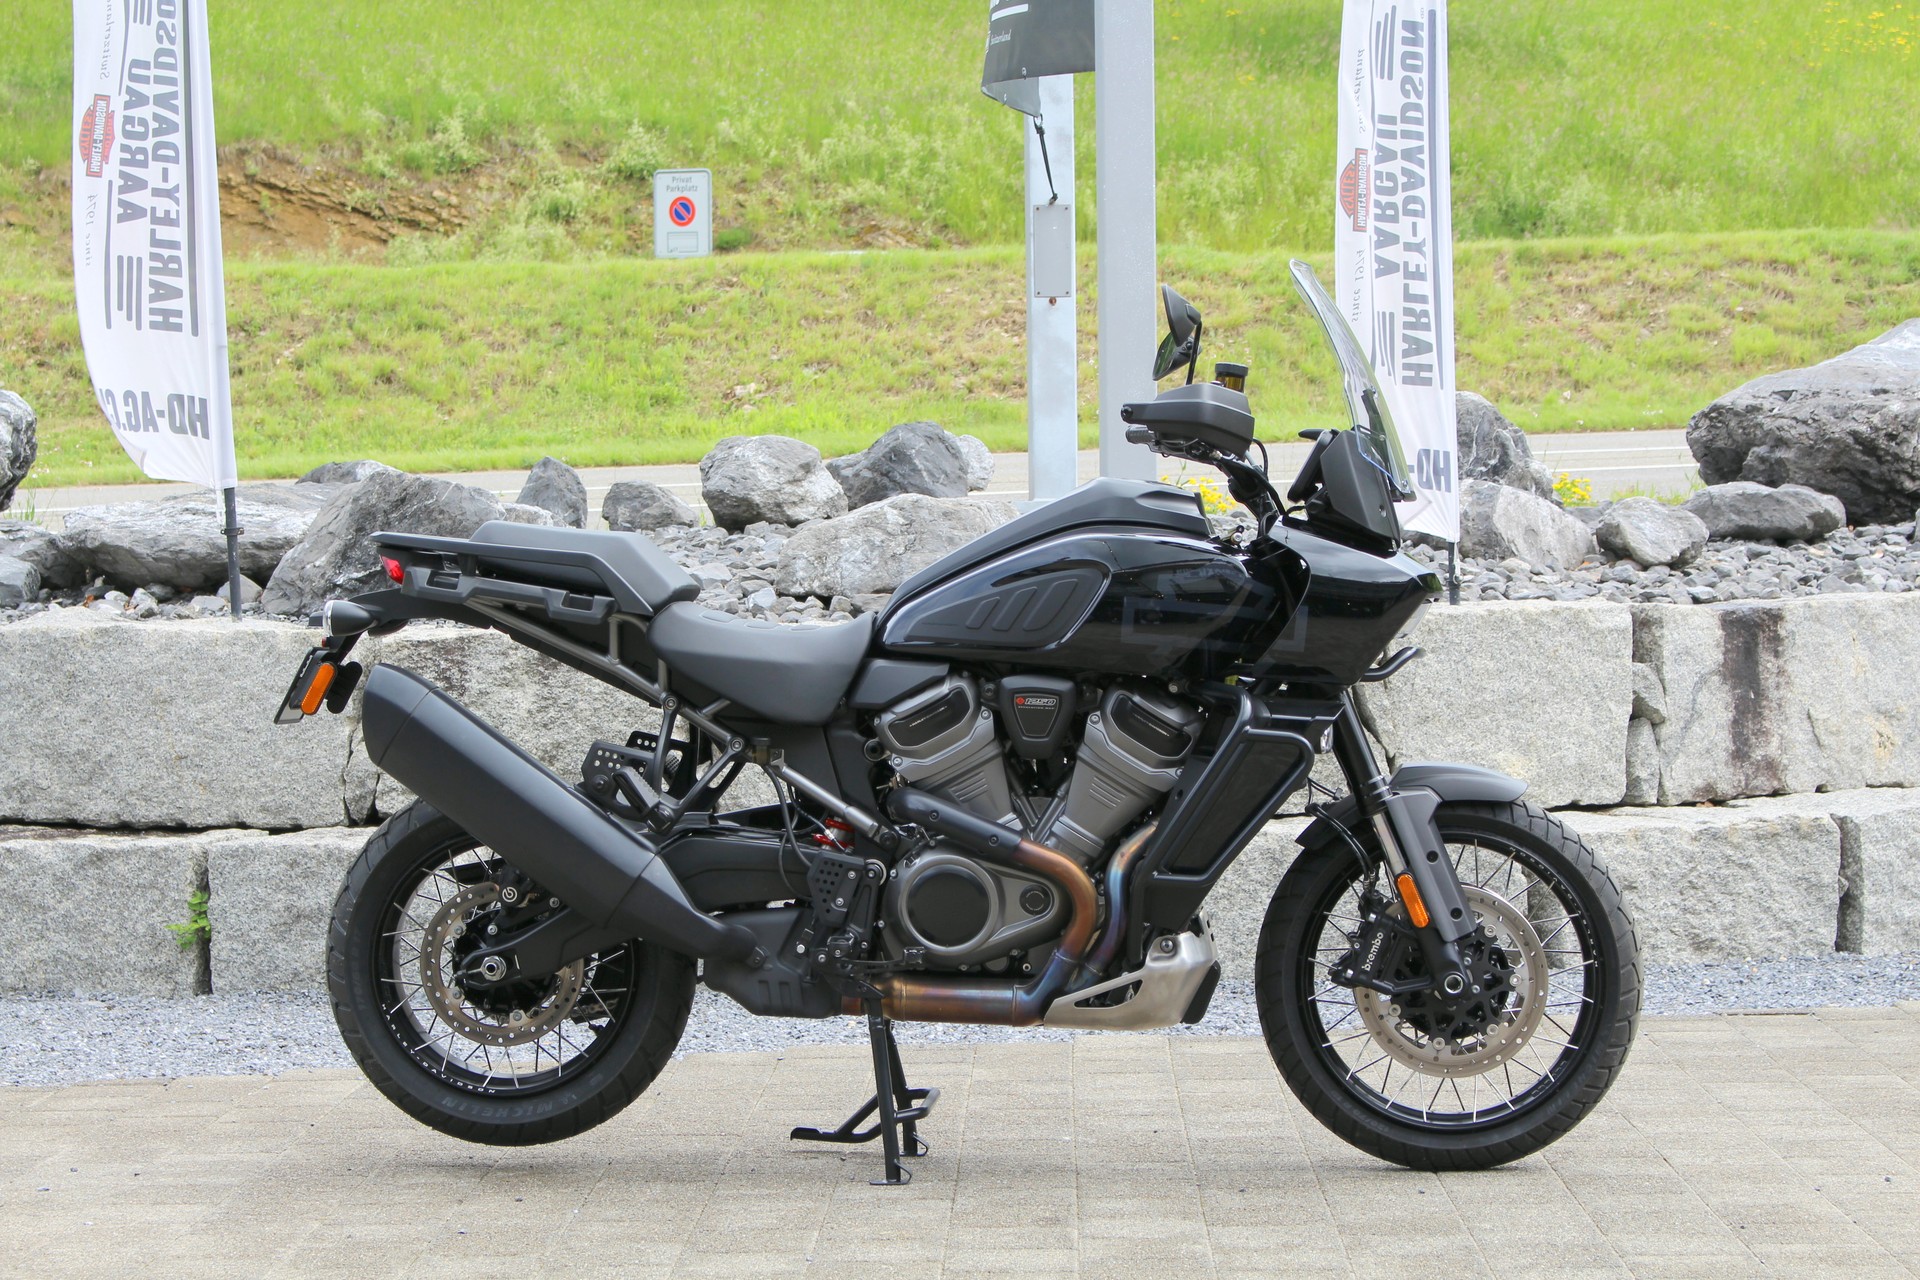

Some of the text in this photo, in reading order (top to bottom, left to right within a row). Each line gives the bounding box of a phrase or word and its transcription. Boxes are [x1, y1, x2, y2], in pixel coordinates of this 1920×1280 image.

[666, 185, 698, 193] Parkplatz
[1361, 932, 1384, 971] brembo
[381, 1003, 496, 1094] HARLEY-DAVIDSON
[441, 1095, 552, 1118] MICHELIN
